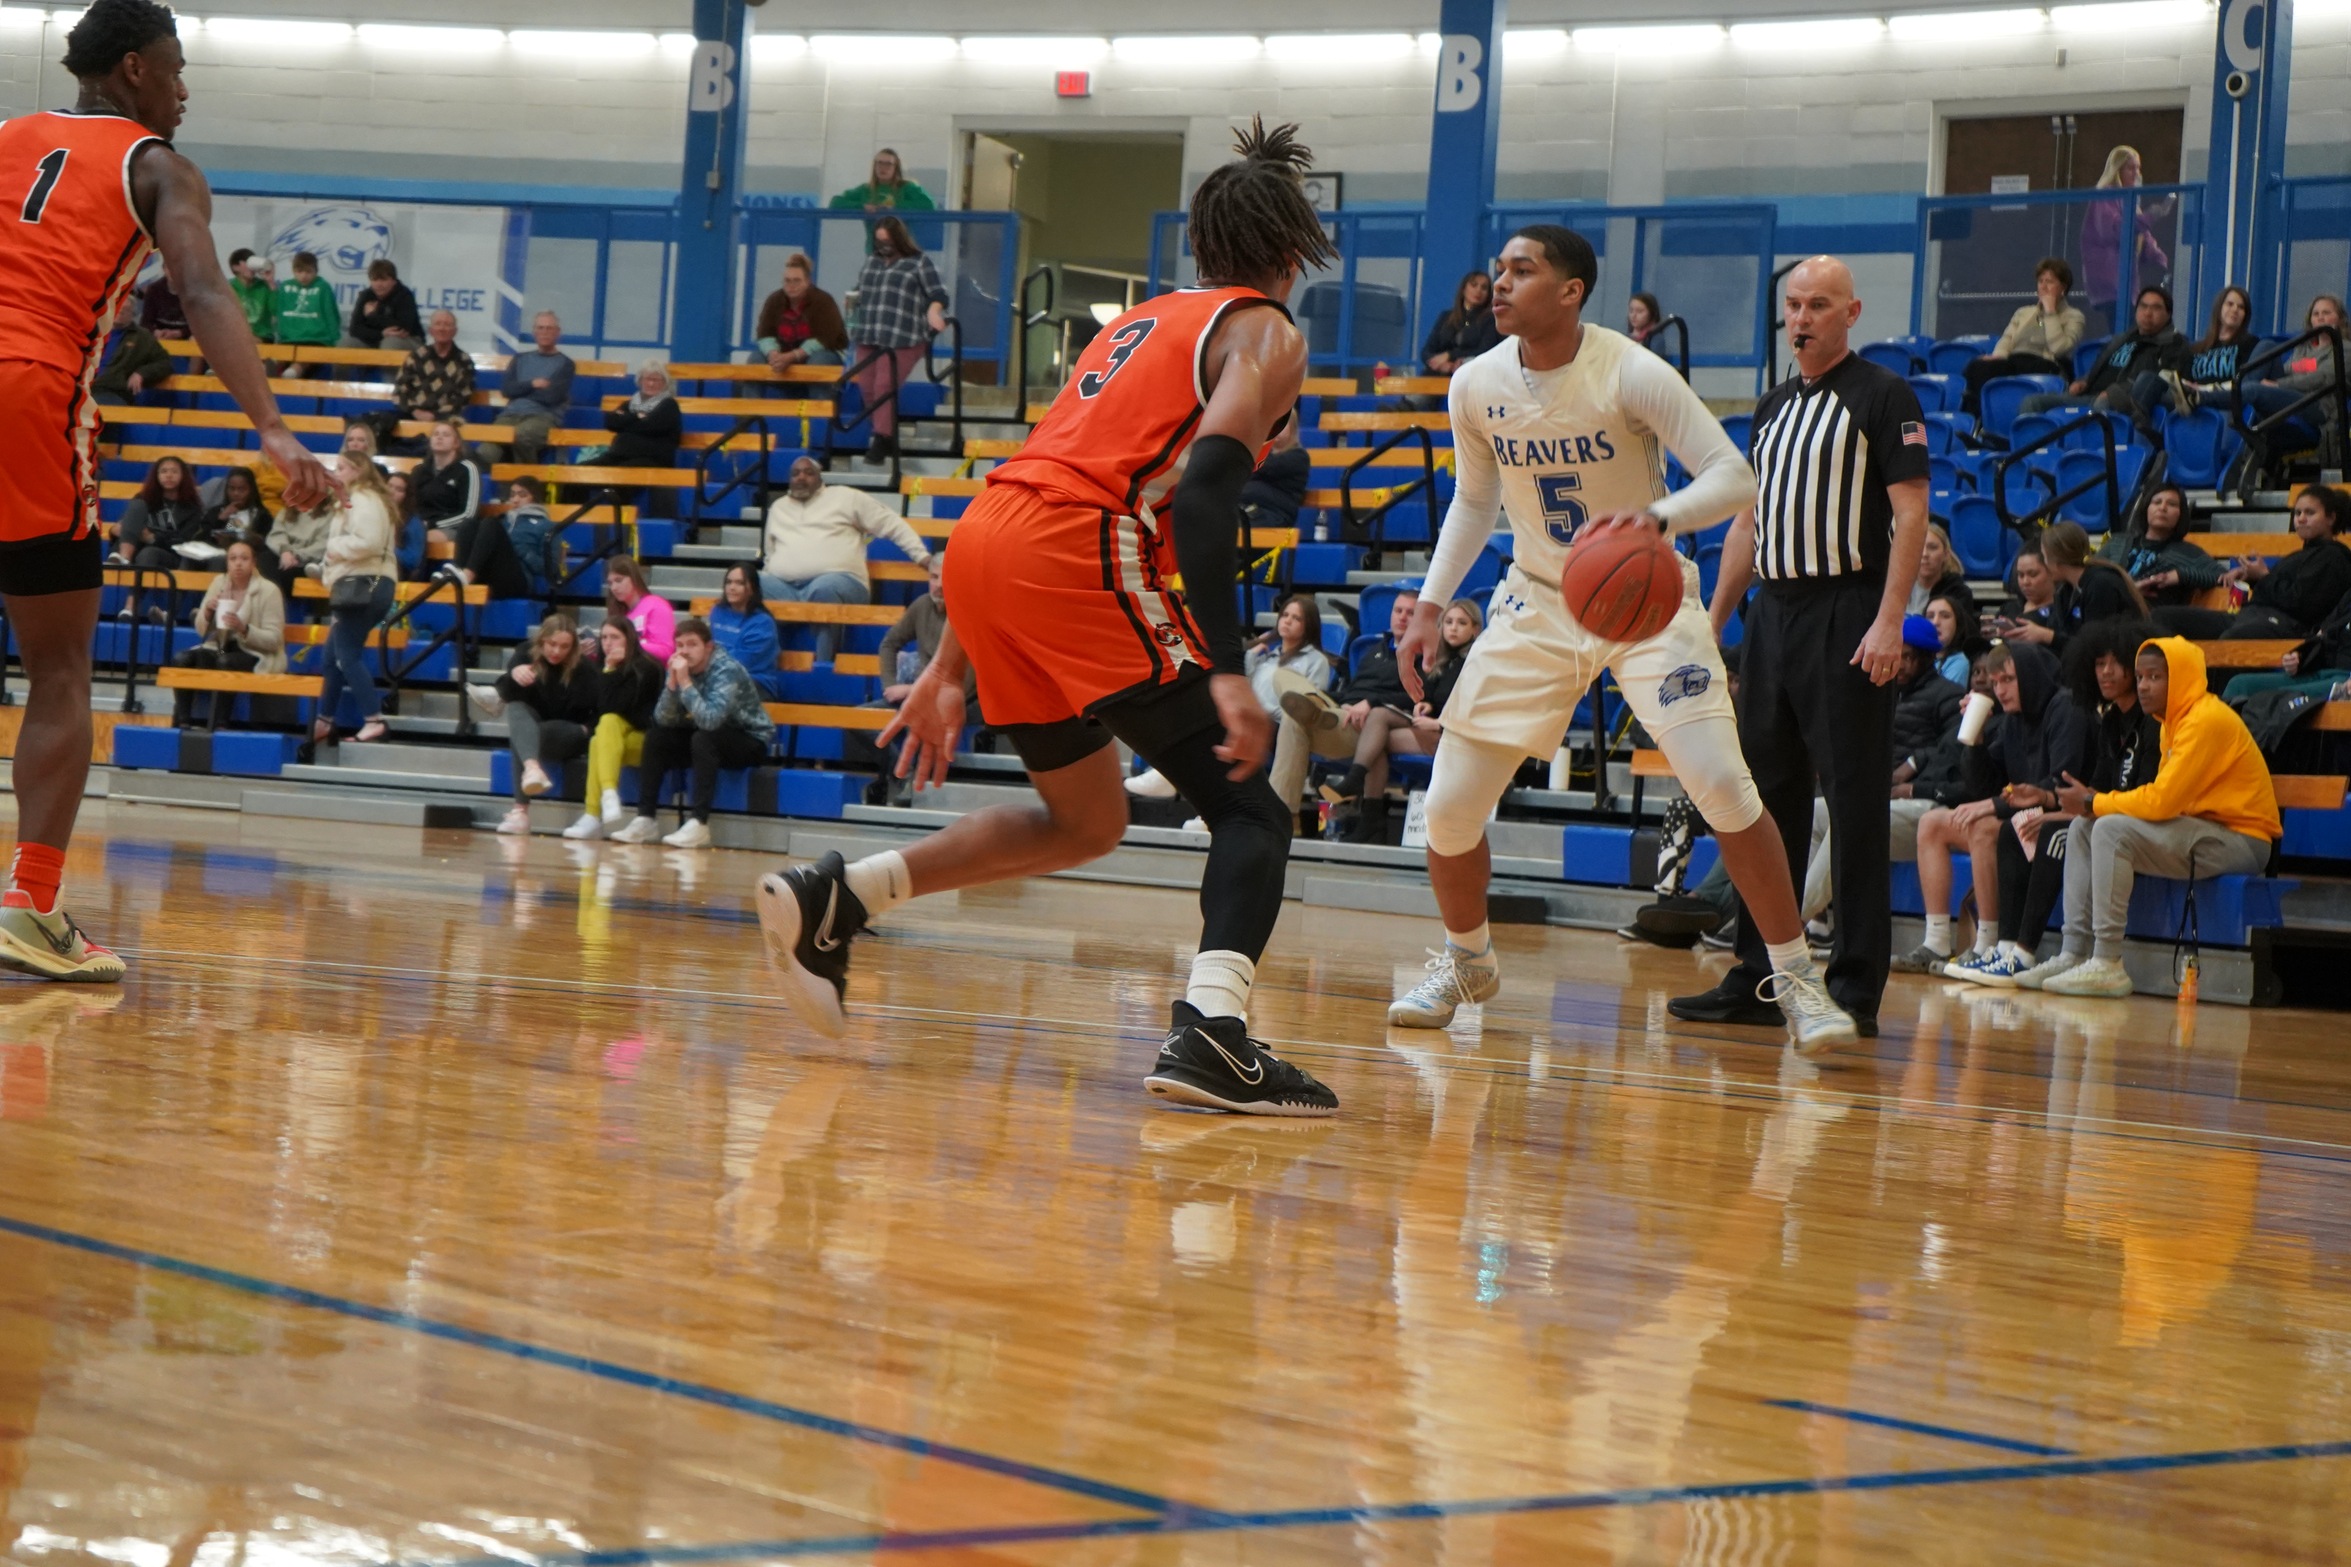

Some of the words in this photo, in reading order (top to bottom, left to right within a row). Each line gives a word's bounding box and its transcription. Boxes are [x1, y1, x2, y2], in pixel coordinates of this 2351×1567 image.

[1437, 34, 1483, 112] B
[2223, 0, 2263, 72] C
[690, 41, 735, 112] B
[19, 148, 71, 224] 1
[1078, 317, 1157, 399] 3
[1492, 430, 1615, 467] BEAVERS
[1534, 472, 1589, 547] 5
